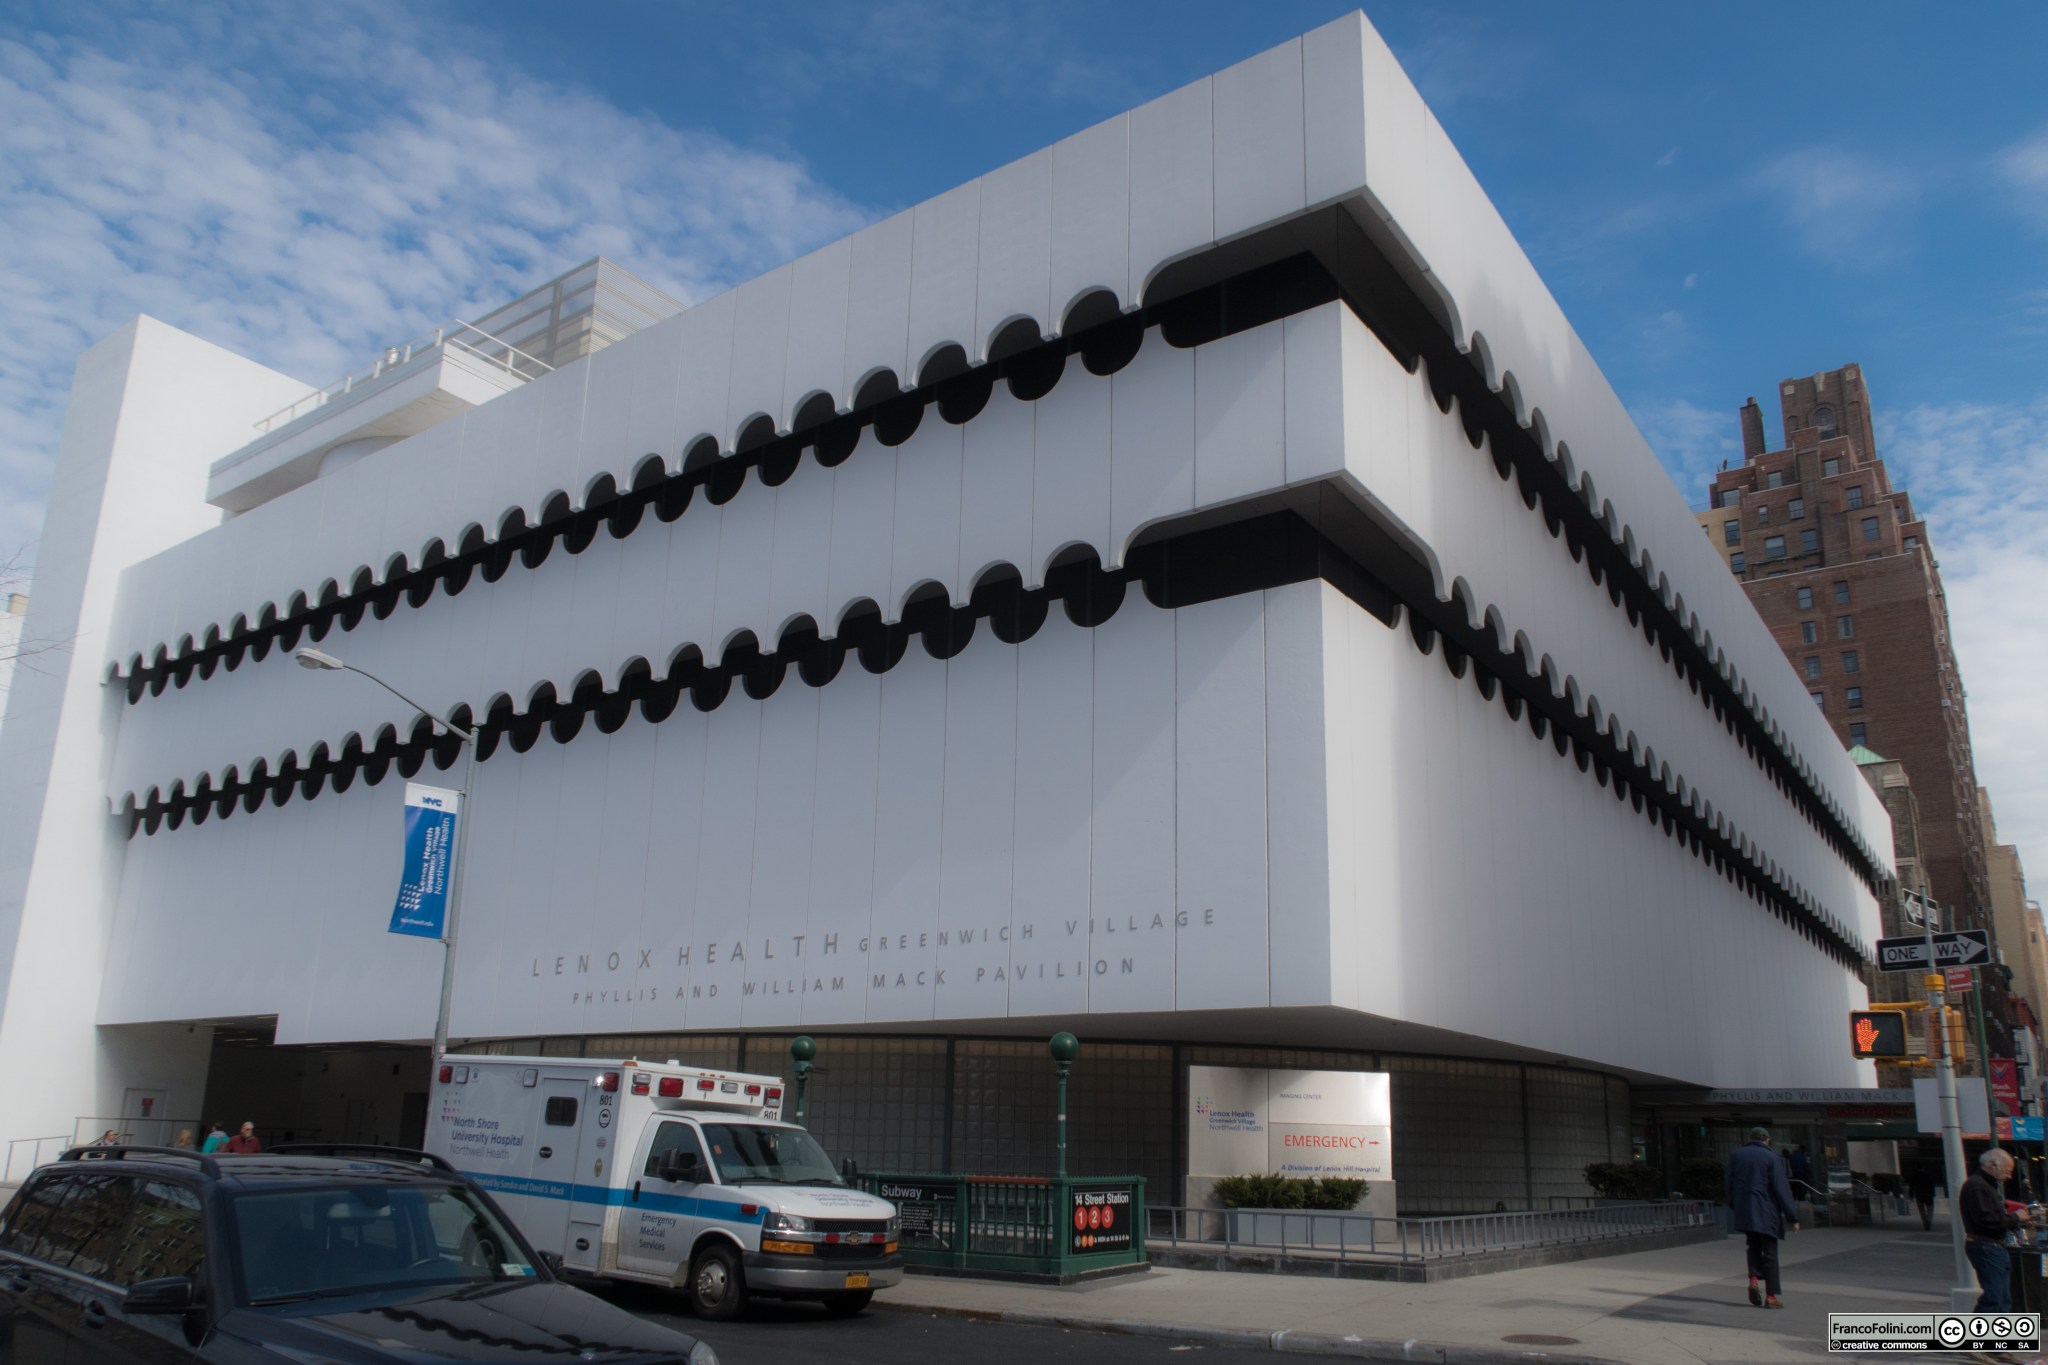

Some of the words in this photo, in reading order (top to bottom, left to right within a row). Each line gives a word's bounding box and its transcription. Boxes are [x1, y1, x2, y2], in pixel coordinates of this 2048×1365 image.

[422, 796, 443, 808] NYC
[422, 827, 434, 860] Health
[433, 850, 448, 896] Northwell
[442, 817, 451, 847] Health
[418, 862, 430, 892] Lenox
[531, 948, 653, 978] LENOX
[676, 932, 840, 967] HEALTH
[858, 924, 1035, 953] GREENWICH
[1066, 908, 1216, 937] VILLAGE
[1887, 947, 1919, 961] ONE
[1937, 942, 1972, 957] WAY
[572, 986, 658, 1005] PHYLLIS
[675, 983, 719, 1001] AND
[743, 976, 846, 997] WILLIAM
[872, 968, 948, 990] MACK
[976, 957, 1135, 984] PAVILION
[600, 1094, 613, 1106] 801
[1712, 1092, 1761, 1101] PHYLLIS
[1766, 1092, 1793, 1101] AND
[1799, 1091, 1856, 1101] WILLIAM
[1861, 1091, 1900, 1101] MACK
[453, 1115, 476, 1129] North
[477, 1117, 500, 1130] Shore
[763, 1110, 778, 1121] 801
[1238, 1118, 1256, 1126] Village
[451, 1129, 489, 1146] University
[490, 1133, 524, 1148] Hospital
[1284, 1134, 1366, 1149] EMERGENCY
[448, 1143, 485, 1158] Northwell
[486, 1146, 510, 1160] Health
[1287, 1164, 1313, 1172] Division
[1314, 1164, 1321, 1172] of
[1355, 1165, 1381, 1174] Hospital
[881, 1184, 922, 1201] Subway
[1075, 1194, 1083, 1206] 14
[1084, 1193, 1106, 1206] Street
[1106, 1193, 1129, 1205] Station
[641, 1212, 678, 1229] Emergency
[640, 1226, 666, 1238] Medical
[639, 1238, 666, 1251] Services
